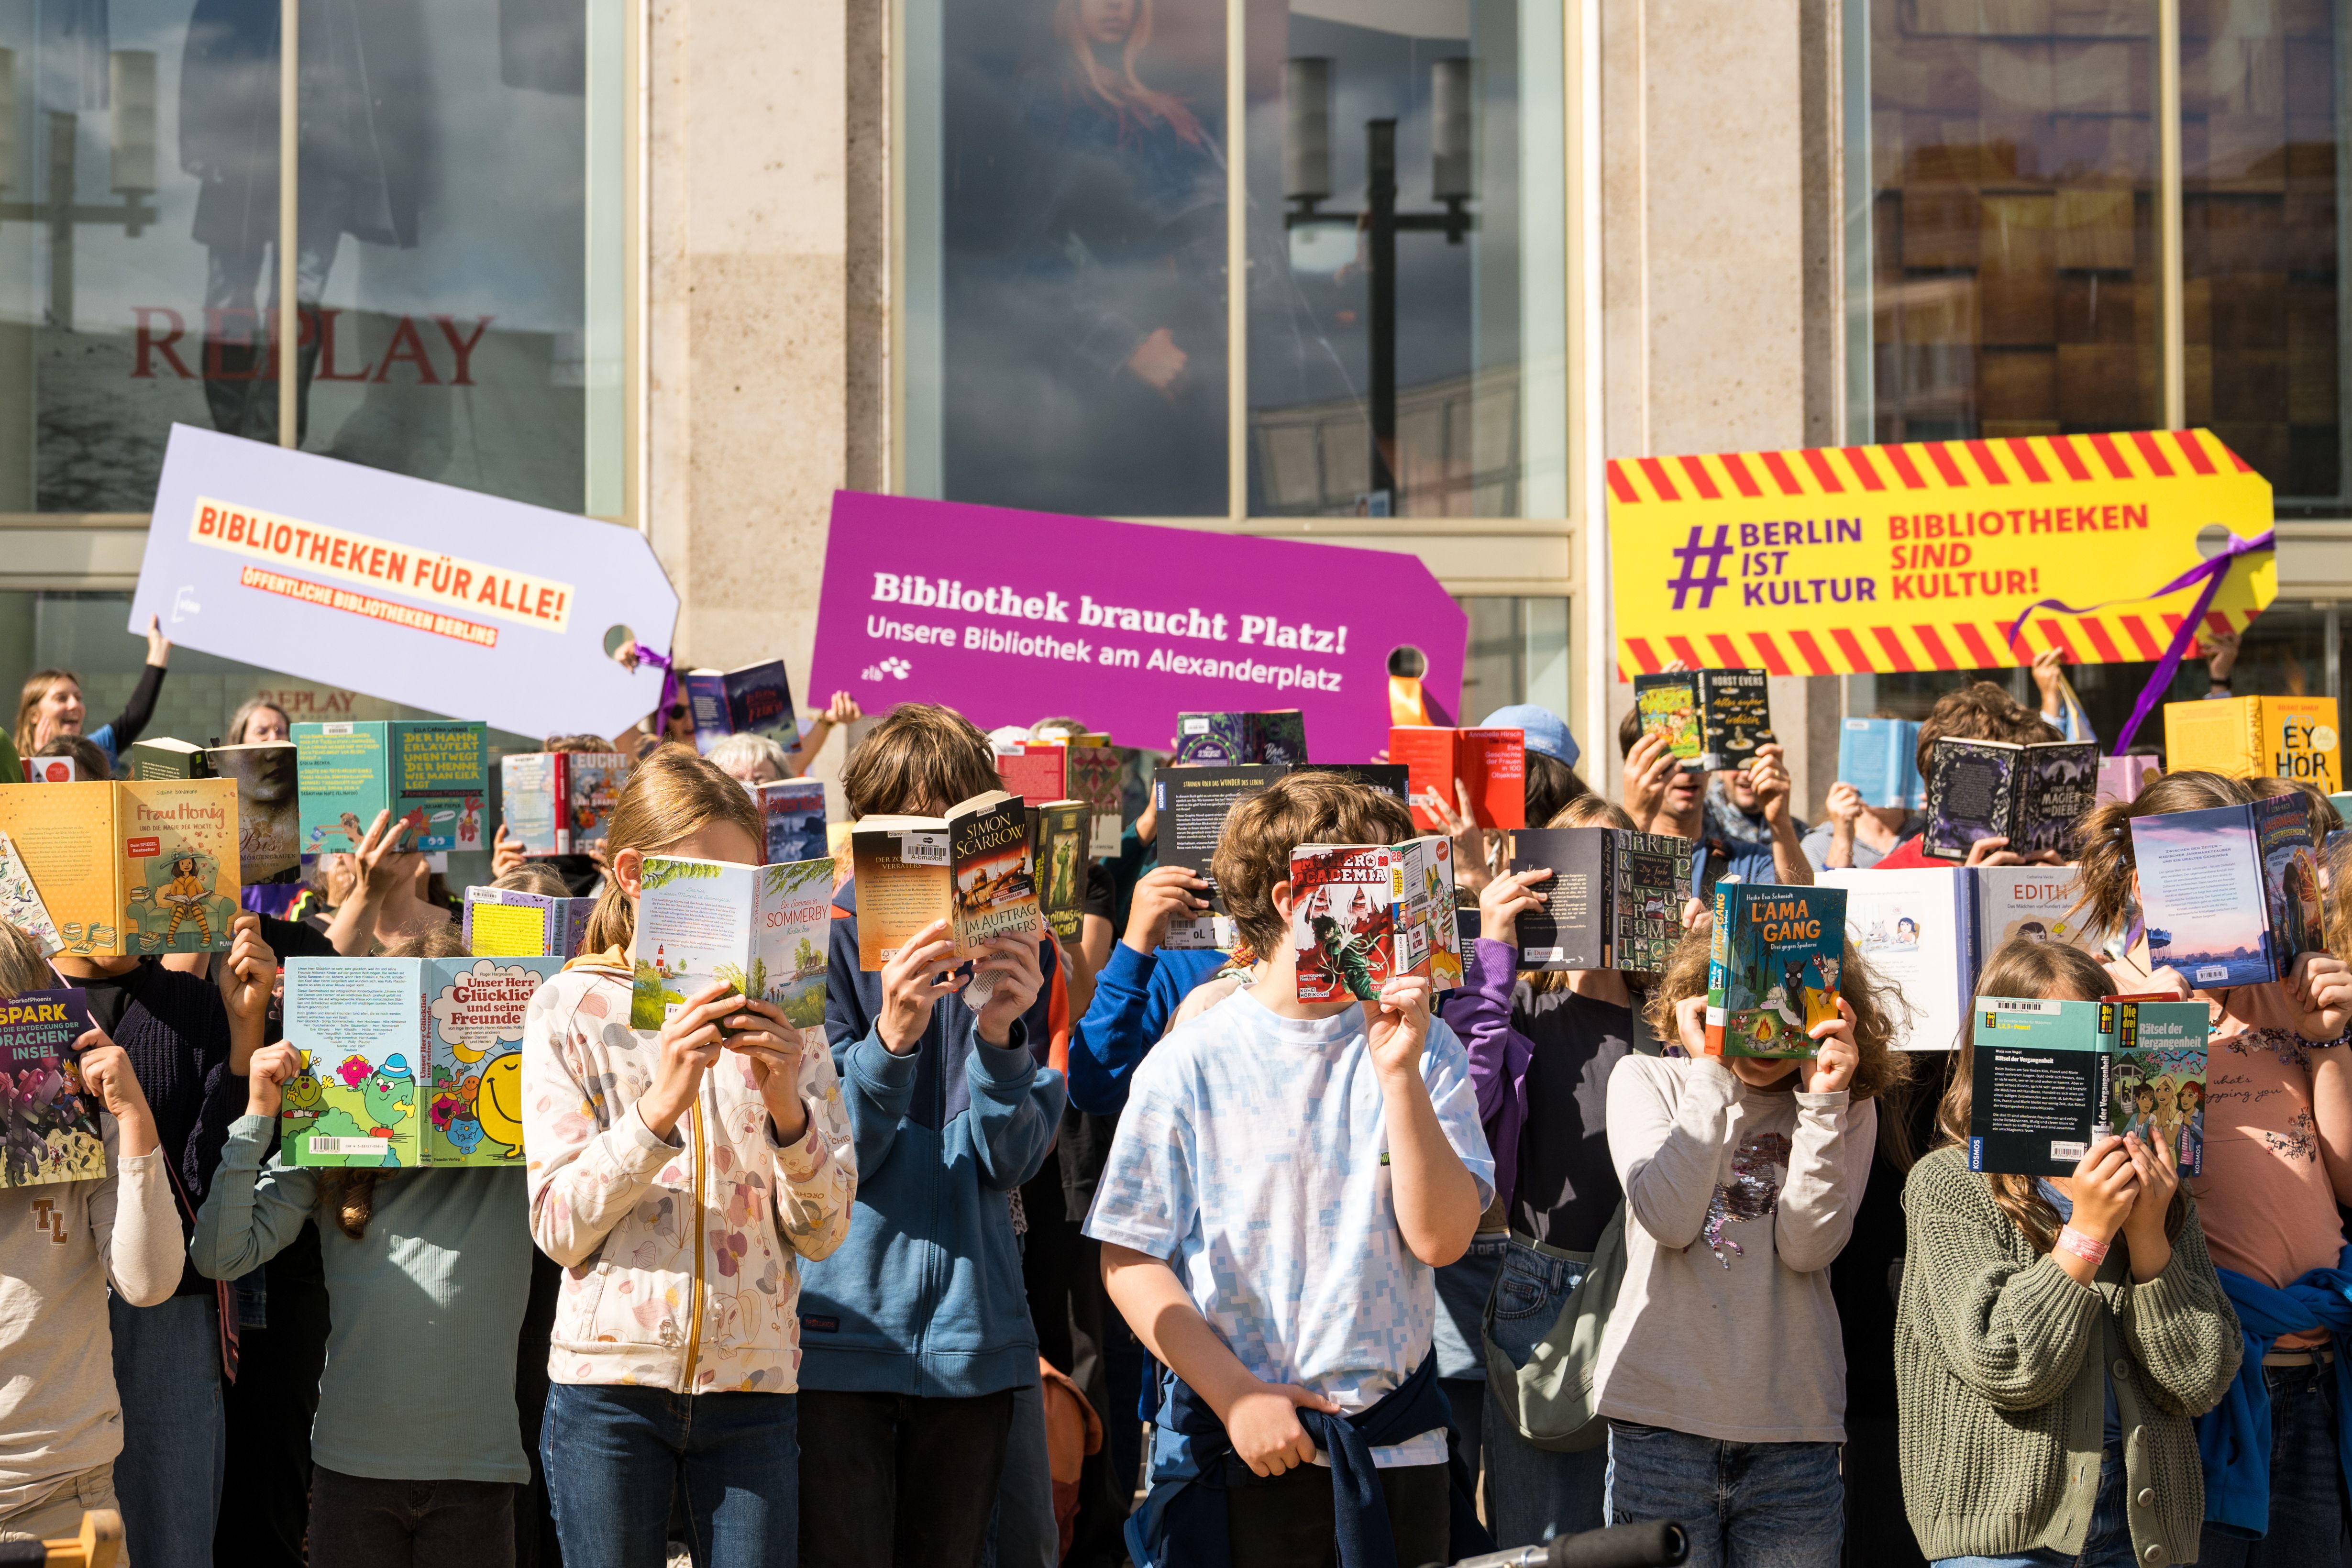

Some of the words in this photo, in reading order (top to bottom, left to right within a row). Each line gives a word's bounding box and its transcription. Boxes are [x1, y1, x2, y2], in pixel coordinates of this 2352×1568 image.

[130, 306, 497, 385] REPLAY
[1889, 504, 2149, 540] BIBLIOTHEKEN
[1740, 518, 1862, 546] BERLIN
[1891, 542, 1972, 570] SIND
[198, 506, 408, 582] BIBLIOTHEKEN
[413, 553, 472, 599] FÜR
[477, 574, 566, 623] ALLE!
[1742, 551, 1789, 576] IST
[1893, 567, 2039, 600] KULTUR!
[1743, 577, 1877, 607] KULTUR
[243, 567, 332, 606] ÖFFENTLICHE
[332, 590, 433, 631] BIBLIOTHEKEN
[434, 614, 495, 646] BERLINS
[871, 573, 1068, 622] Bibliothek
[1078, 596, 1228, 640] braucht
[1242, 617, 1347, 654] Platz!
[867, 616, 957, 647] Unsere
[964, 626, 1090, 663] Bibliothek
[1099, 647, 1139, 668] am
[1146, 648, 1342, 692] Alexanderplatz
[1712, 676, 1737, 685] HORST
[1739, 676, 1763, 685] EVERS
[403, 733, 432, 741] DER
[435, 733, 477, 741] HAHN
[2285, 726, 2314, 748] EY
[404, 742, 479, 752] ERLÄUTERT
[404, 752, 479, 762] UNENTWEGT
[571, 753, 627, 769] LEUCHT
[405, 762, 432, 772] DER
[436, 762, 482, 771] HENNE,
[2276, 752, 2330, 777] HÖR
[454, 771, 480, 779] EIER
[406, 781, 429, 789] LEGT
[2042, 791, 2080, 805] MAGIER
[138, 804, 176, 820] Frau
[179, 803, 225, 829] Honig
[978, 806, 994, 816] blanvalet
[2052, 804, 2078, 816] DIEBE
[967, 813, 1010, 839] SIMON
[2263, 814, 2304, 835] JAHRMARKT
[957, 824, 1025, 859] SCARROW
[2270, 829, 2306, 844] ZEITREISENDEN
[1323, 854, 1376, 869] HERO
[1378, 856, 1388, 867] 28
[1391, 851, 1401, 862] 28
[1635, 863, 1650, 873] Die
[1296, 868, 1387, 887] ACADEMIA
[993, 890, 1008, 898] SPIEGEL
[1010, 883, 1026, 892] ONLINE
[999, 891, 1022, 902] BESTSELLER
[2014, 885, 2067, 899] EDITH
[781, 900, 789, 909] Ein
[791, 898, 811, 908] Sommer
[767, 905, 828, 928] SOMMERBY
[1752, 900, 1809, 922] LAMA
[965, 919, 981, 936] IM
[982, 903, 1036, 929] AUFTRAG
[787, 927, 800, 935] Kirsten
[1763, 920, 1821, 942] GANG
[467, 978, 503, 987] Unser
[506, 978, 534, 987] Herr
[8, 996, 51, 1005] SparkofPhoenix
[467, 1003, 491, 1012] und
[494, 1003, 525, 1011] seine
[0, 1004, 68, 1025] SPARK
[2123, 1005, 2136, 1017] Die
[451, 1012, 520, 1025] Freunde
[2123, 1018, 2135, 1028] drei
[17, 1023, 63, 1031] ENTDECKUNG
[2139, 1023, 2166, 1034] Rätsel
[2168, 1023, 2183, 1034] der
[2139, 1036, 2201, 1050] Vergangenheit
[13, 1046, 59, 1060] INSEL
[2099, 1055, 2109, 1107] Vergangenheit
[2213, 1075, 2252, 1085] what's
[2255, 1088, 2282, 1102] you
[2098, 1109, 2107, 1120] der
